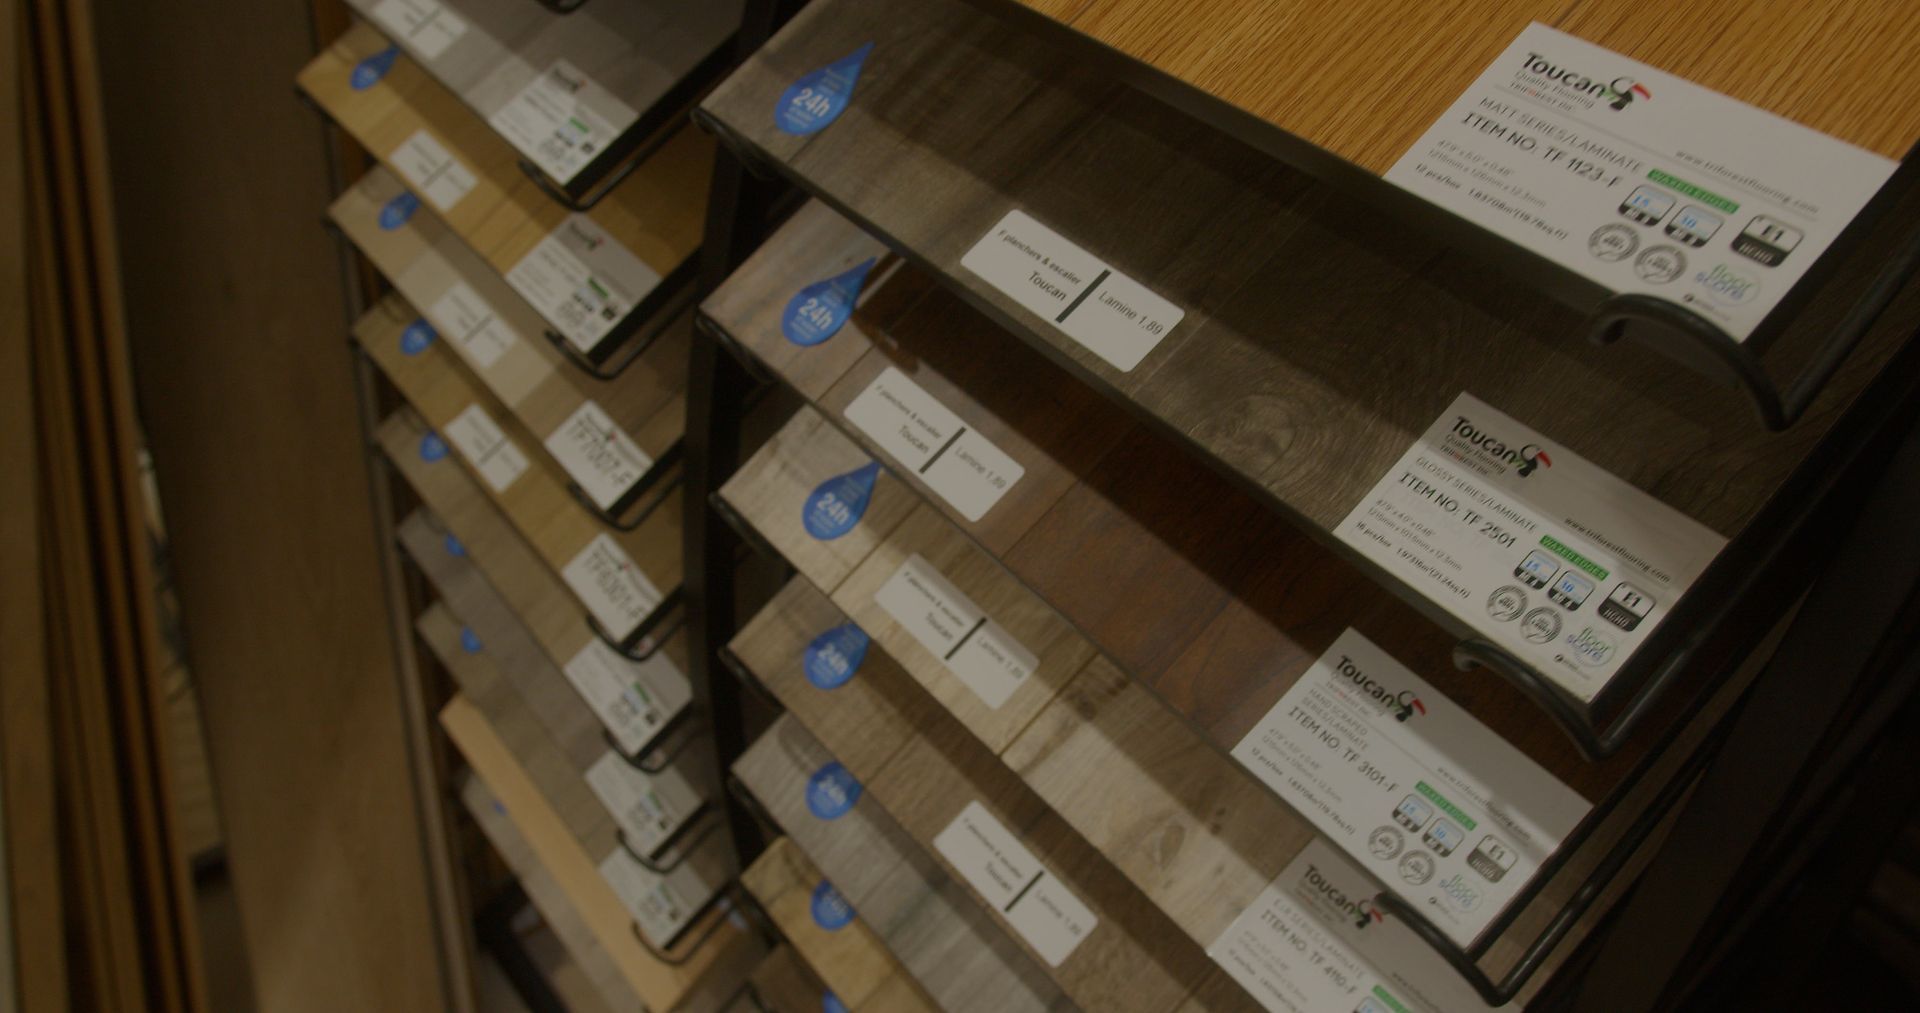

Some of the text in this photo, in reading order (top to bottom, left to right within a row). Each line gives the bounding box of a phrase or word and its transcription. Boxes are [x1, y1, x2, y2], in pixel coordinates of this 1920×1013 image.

[1515, 50, 1614, 98] Toucan
[792, 87, 830, 117] 24h
[1459, 111, 1625, 189] ITEM NO: TF 1123-F
[1476, 96, 1648, 174] MATT SERIES/LAMINATE
[1002, 233, 1043, 261] planchers
[1047, 260, 1083, 285] escalier
[1025, 270, 1070, 302] Toucan
[798, 297, 832, 330] 24h
[896, 424, 932, 455] Toucan
[1447, 414, 1523, 464] Toucan
[816, 492, 850, 526] 24h
[1398, 471, 1517, 549] ITEM NO: TF 2501
[1414, 455, 1538, 533] GLOSSY SERIES/LAMINATE
[1621, 590, 1643, 608] E1
[816, 642, 849, 675] 24h
[1332, 654, 1399, 708] Toucan
[1300, 695, 1369, 751] SERIES/LAMINATE
[1308, 687, 1370, 737] HAND SCRAPED
[1287, 705, 1400, 796] ITEM NO: TF 3101-F
[1487, 843, 1506, 861] E1
[1300, 863, 1360, 916] Toucan
[1259, 907, 1291, 937] ITEM
[1308, 950, 1325, 967] TF
